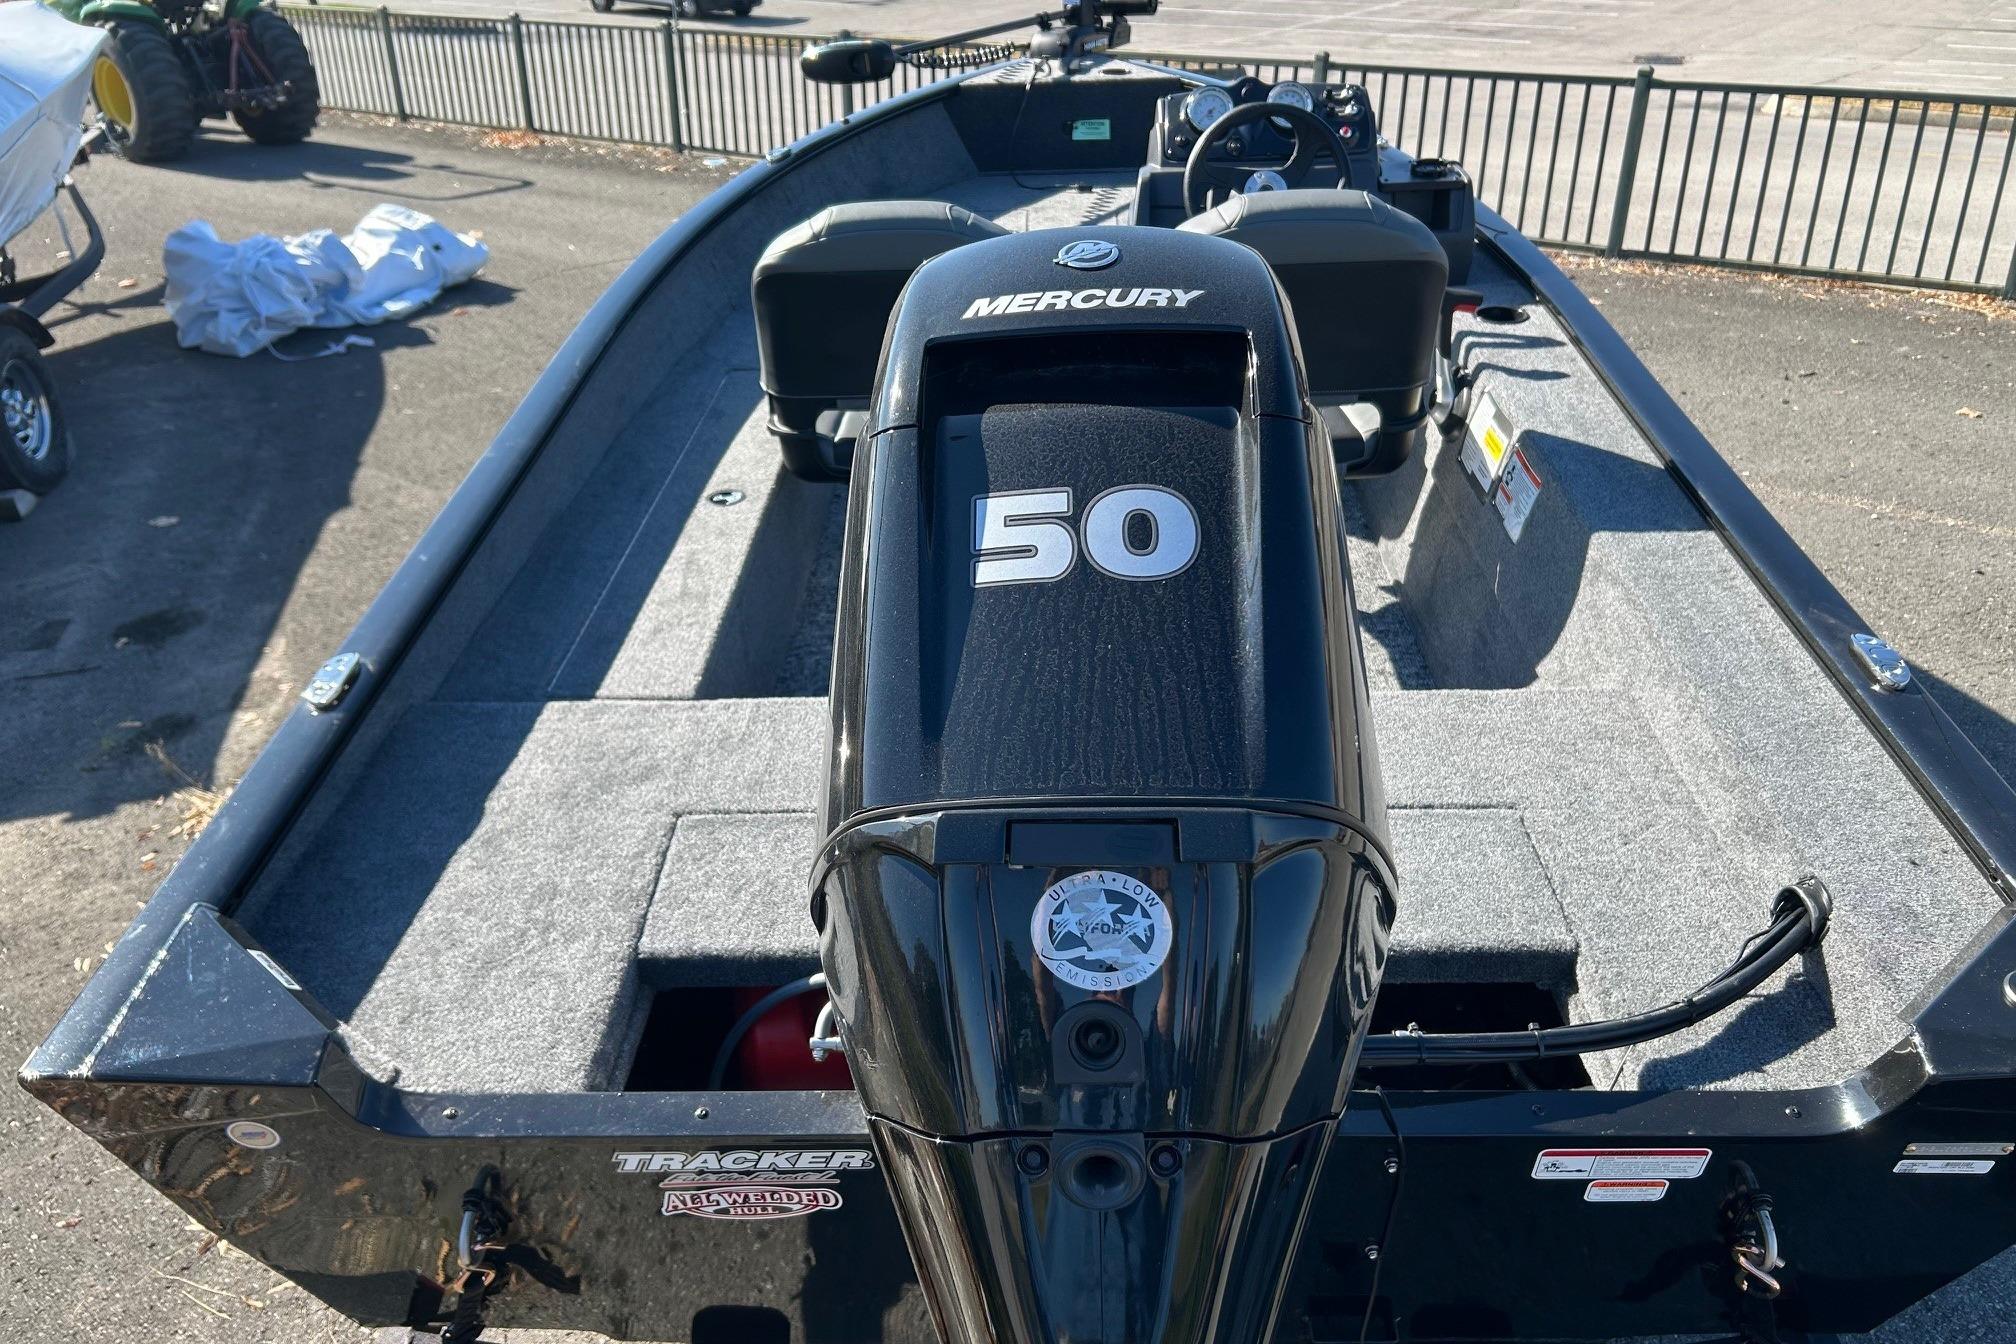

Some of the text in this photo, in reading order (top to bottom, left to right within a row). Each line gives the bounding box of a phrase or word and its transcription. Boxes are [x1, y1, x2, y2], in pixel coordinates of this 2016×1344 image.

[960, 288, 1205, 319] MERCURY
[970, 484, 1201, 588] 50
[1122, 879, 1159, 908] LOW
[1055, 961, 1147, 987] EMISSION
[614, 1150, 873, 1171] TRACKER
[667, 1190, 838, 1211] ALL WELDED
[729, 1205, 779, 1215] HULL
